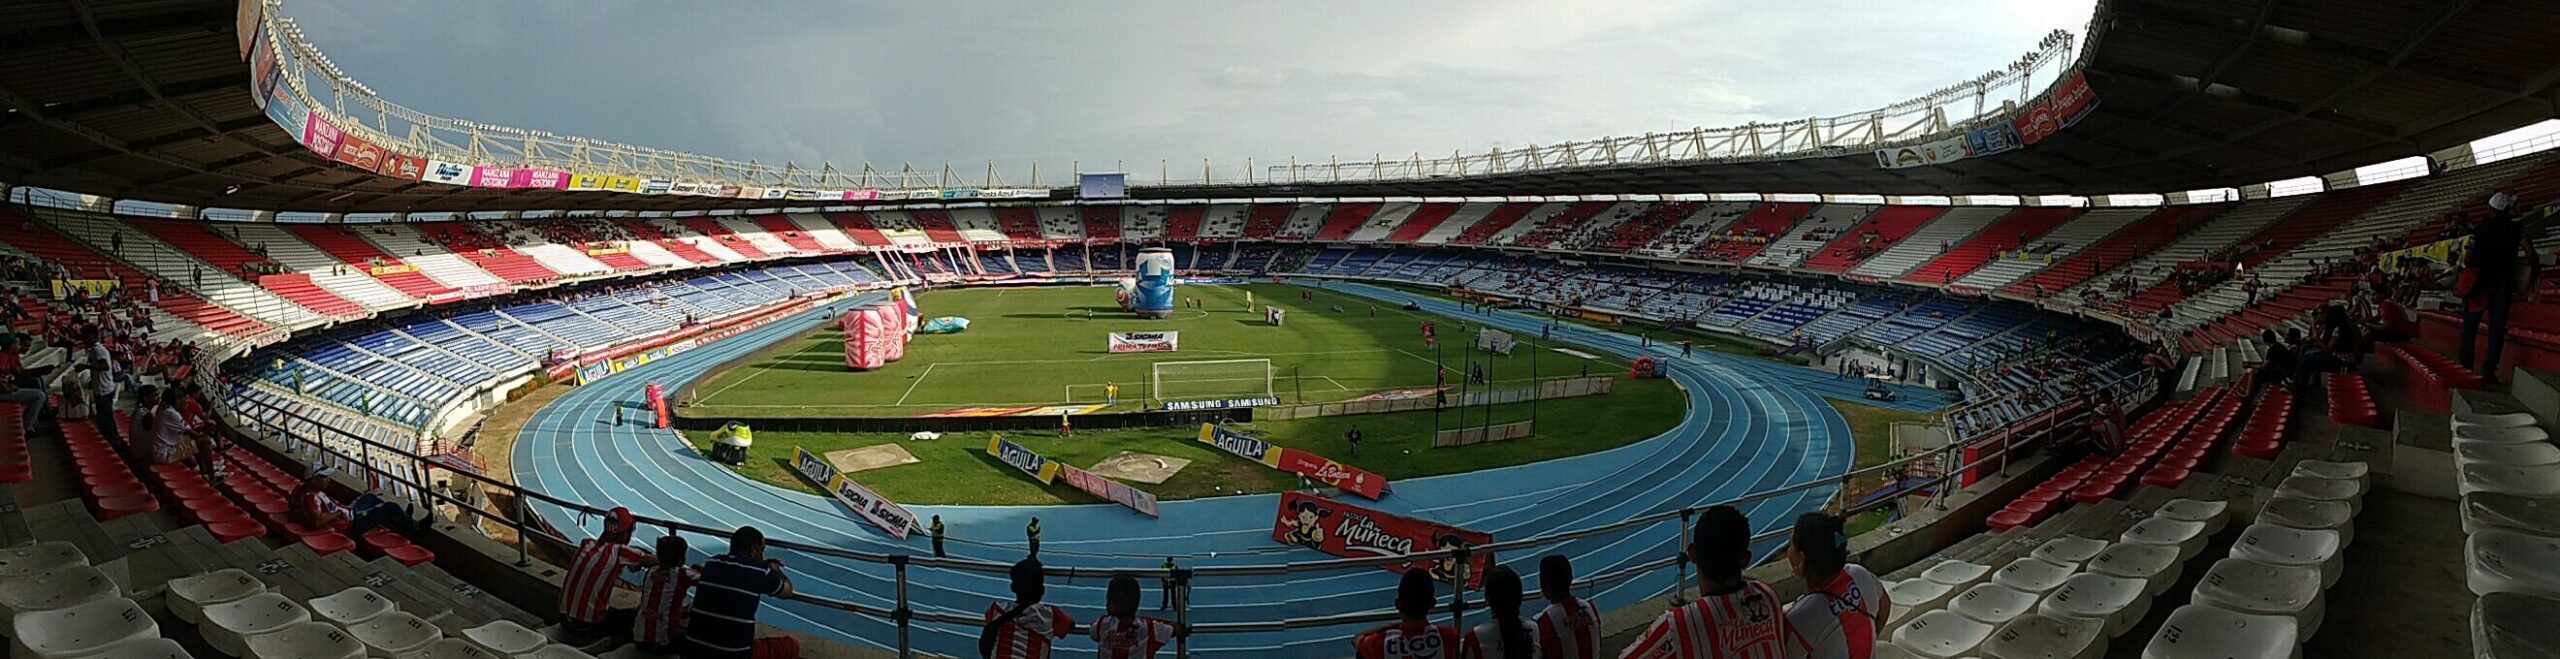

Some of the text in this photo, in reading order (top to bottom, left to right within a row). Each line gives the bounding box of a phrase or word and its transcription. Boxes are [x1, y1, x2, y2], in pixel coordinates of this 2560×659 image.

[1167, 397, 1278, 410] SAMSUNG SAMSUNG
[1002, 446, 1038, 470] AGUILA
[1217, 436, 1262, 457] AGUILA
[801, 458, 829, 482] AGUILA
[845, 488, 868, 508] SIGMA
[877, 508, 908, 530] SIGMA
[1360, 516, 1374, 530] La
[1334, 518, 1412, 556] Muñeca
[1828, 583, 1862, 616] tigo
[1386, 633, 1442, 658] tigo
[1720, 618, 1774, 650] Muñeca
